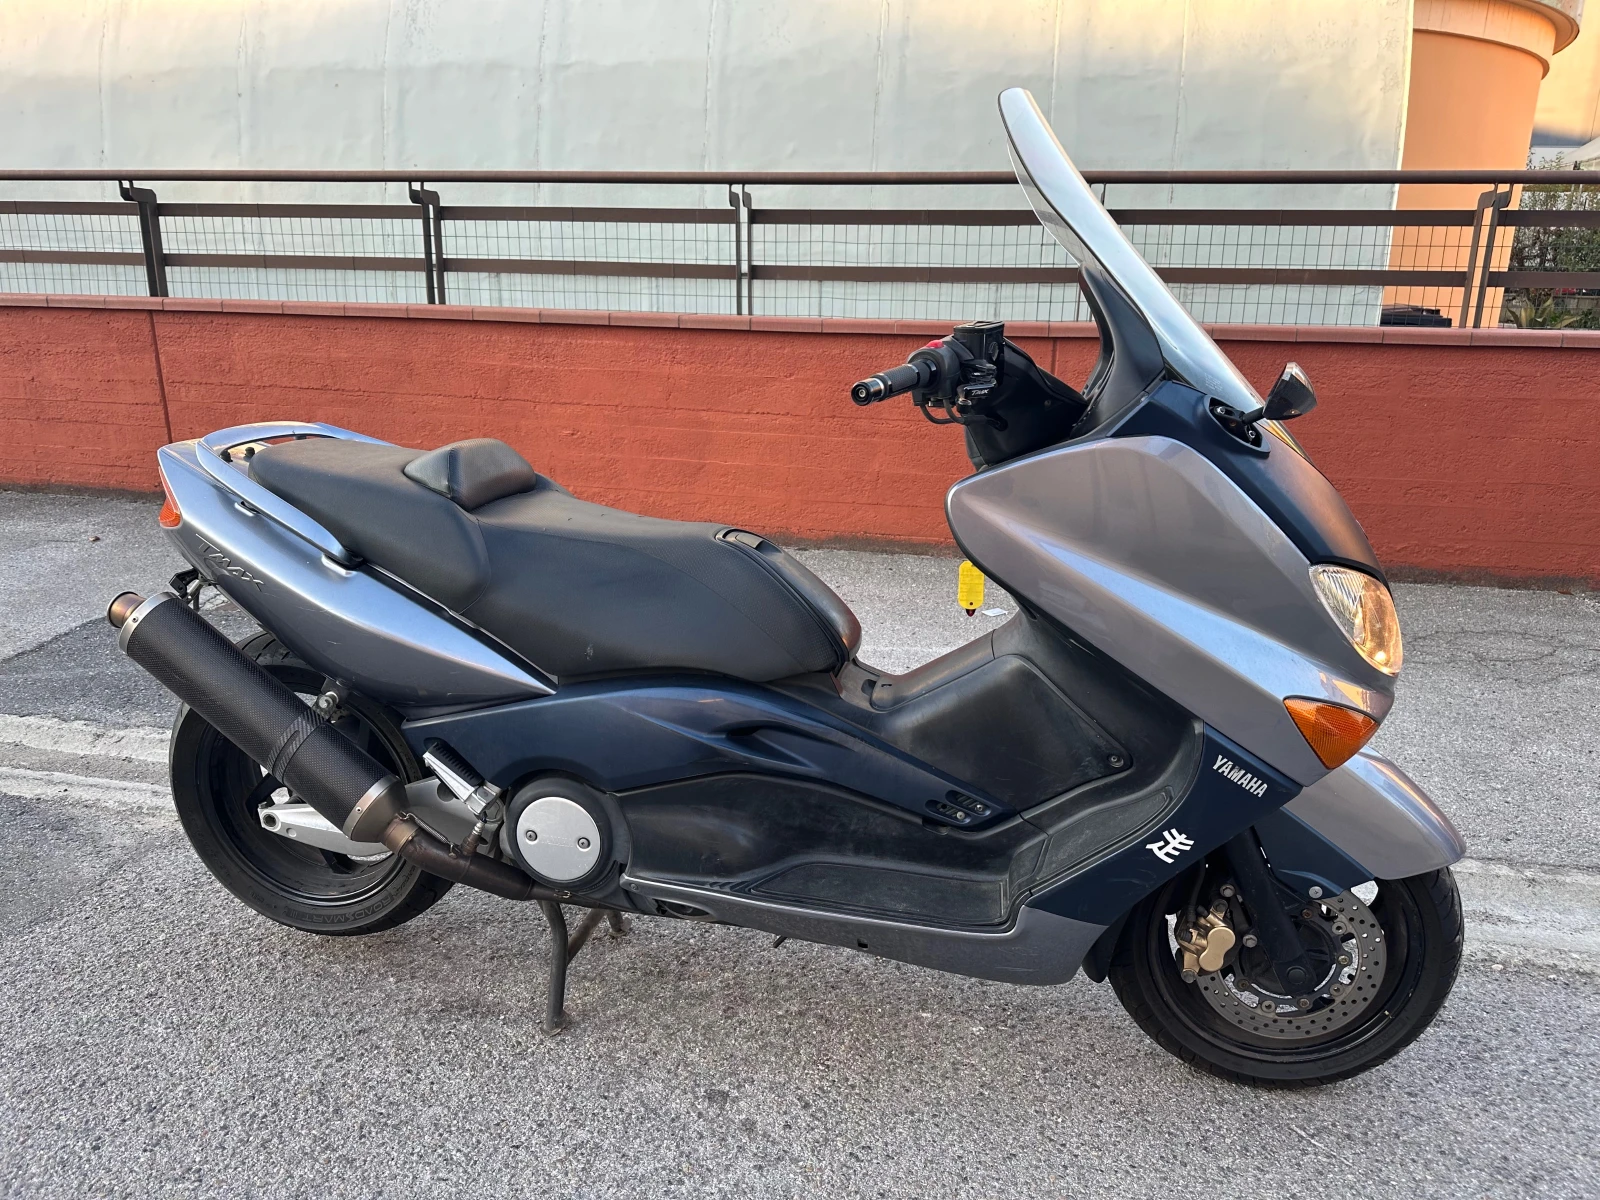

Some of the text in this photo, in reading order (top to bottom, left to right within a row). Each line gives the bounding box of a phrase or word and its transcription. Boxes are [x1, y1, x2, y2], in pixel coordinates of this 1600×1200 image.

[196, 533, 264, 592] TMAX
[1212, 755, 1268, 798] YAMAHA
[302, 898, 392, 923] ROADSMART
